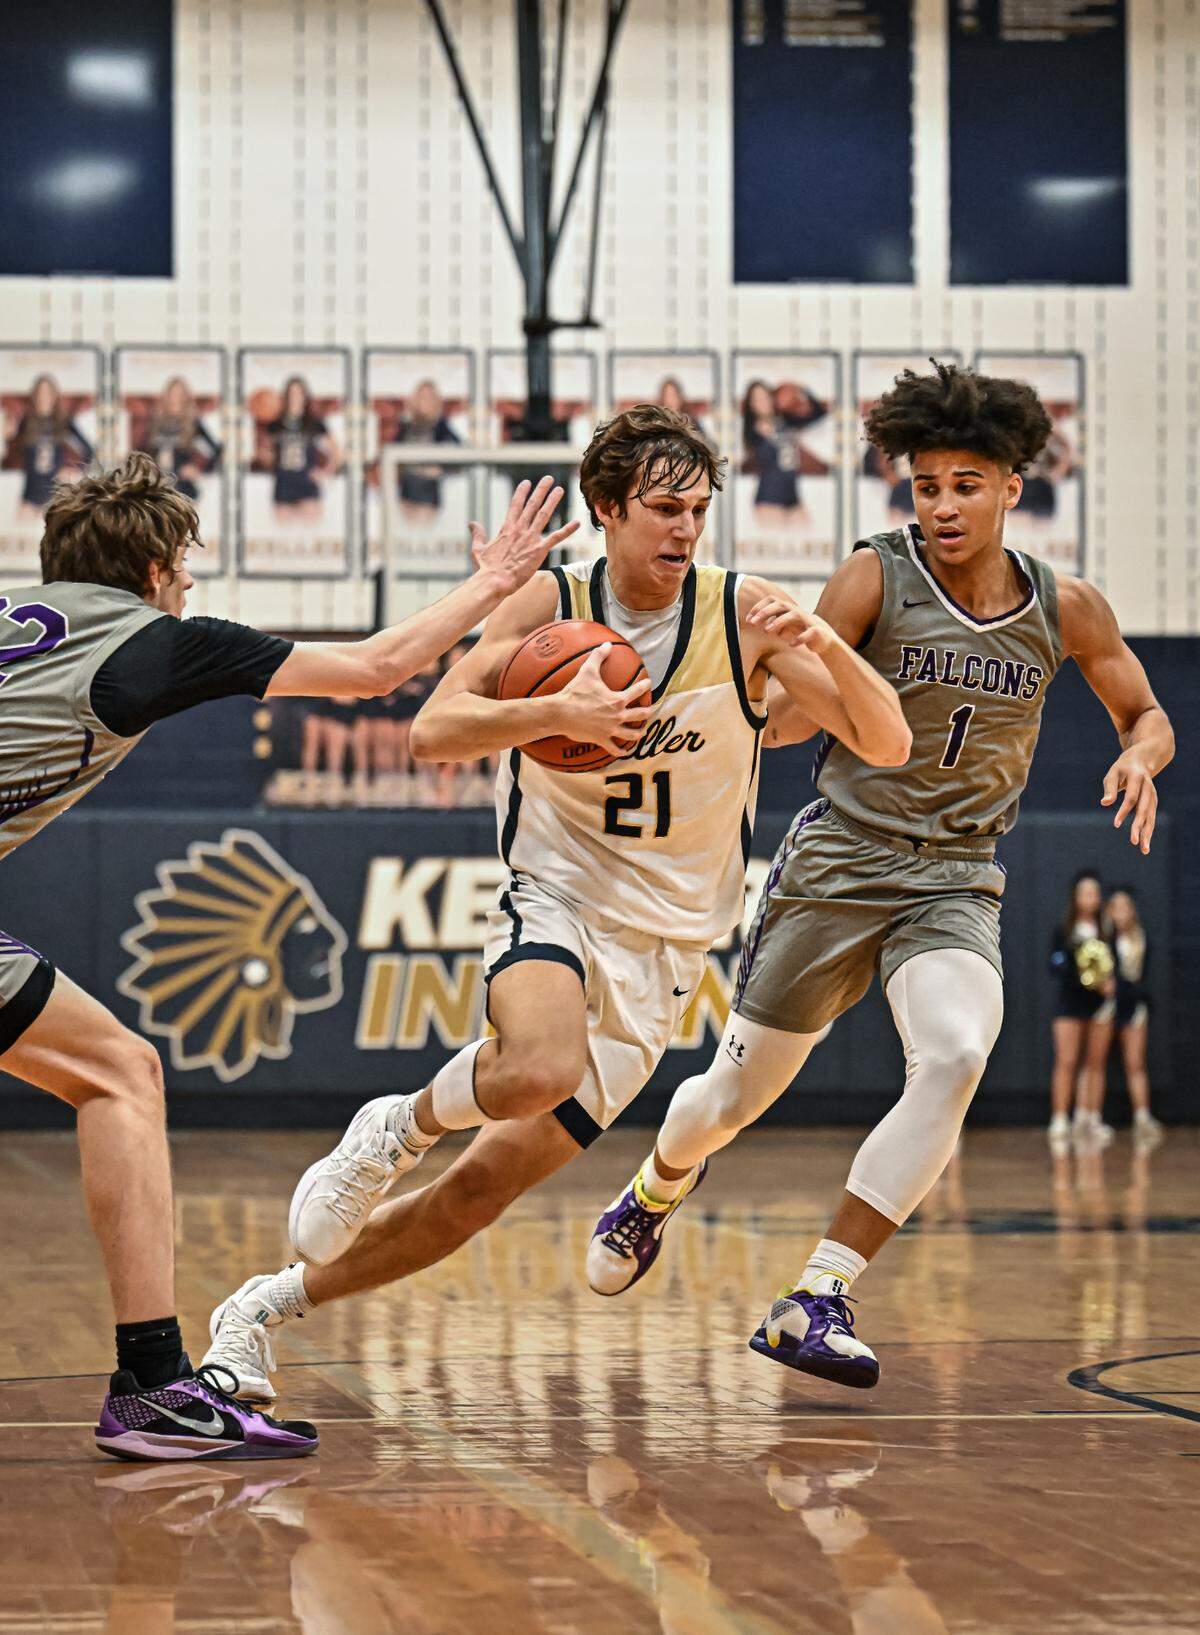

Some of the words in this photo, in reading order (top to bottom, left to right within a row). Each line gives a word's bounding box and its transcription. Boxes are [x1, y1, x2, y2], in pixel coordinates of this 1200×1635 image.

[897, 644, 1044, 700] FALCONS
[616, 715, 706, 761] ller
[938, 703, 976, 769] 1
[603, 770, 671, 839] 21
